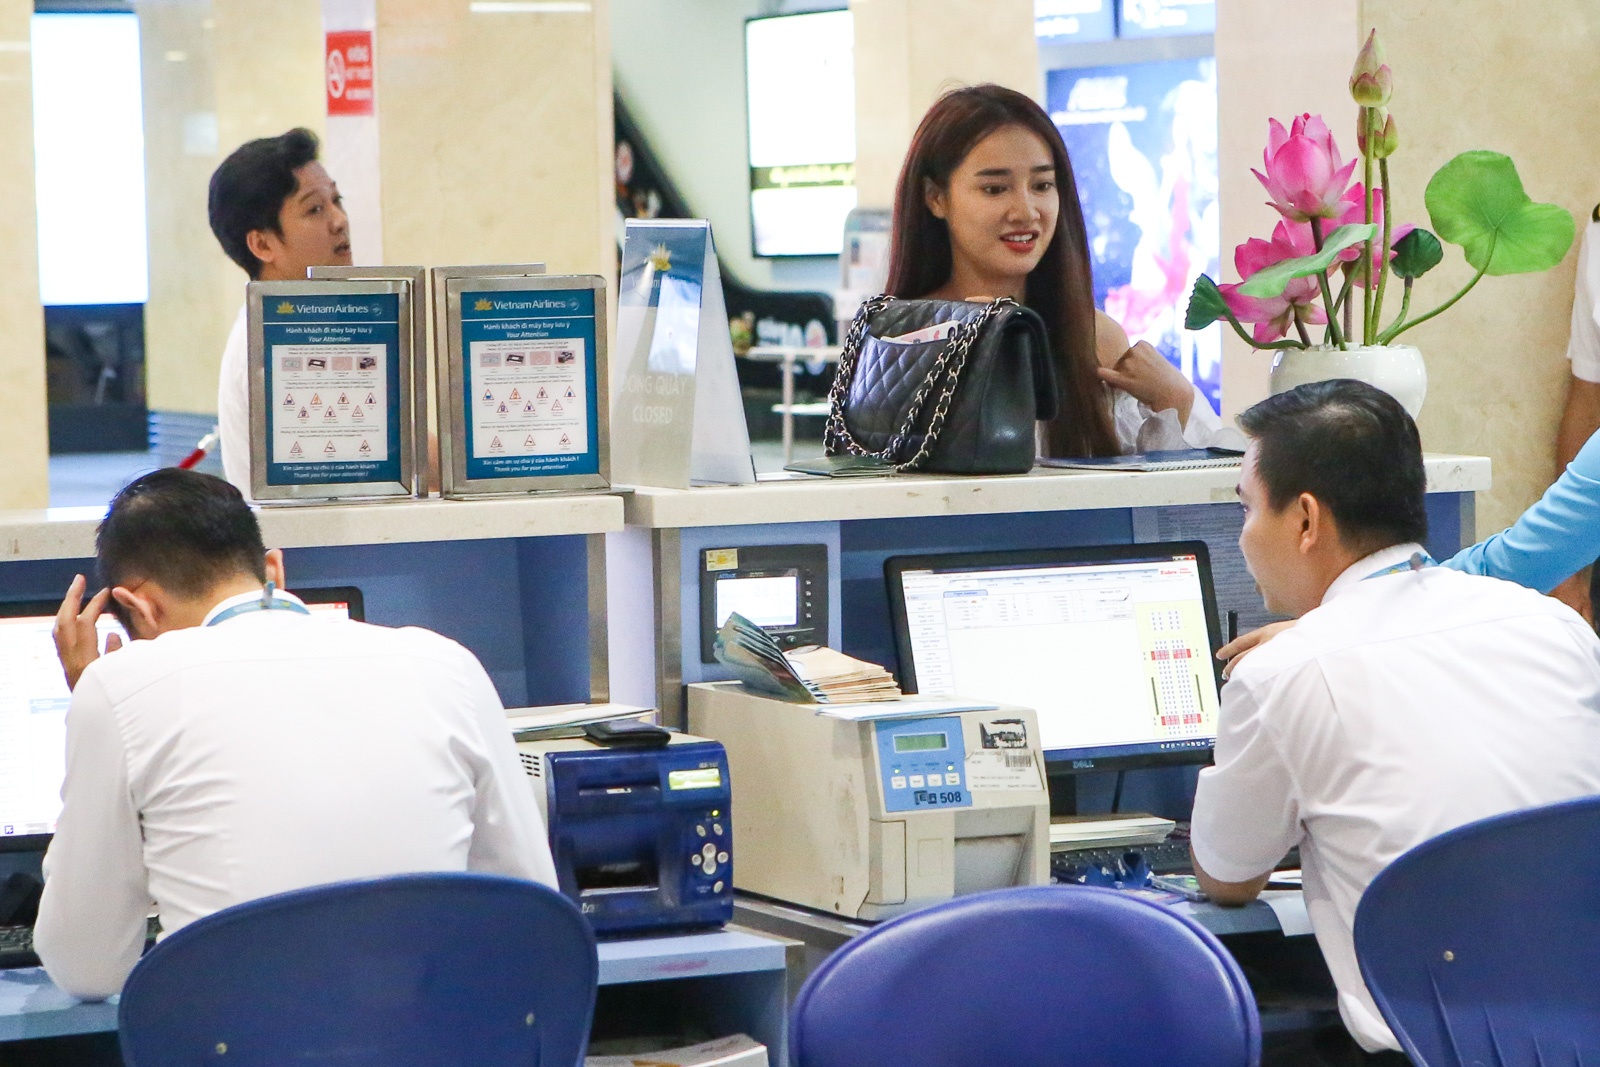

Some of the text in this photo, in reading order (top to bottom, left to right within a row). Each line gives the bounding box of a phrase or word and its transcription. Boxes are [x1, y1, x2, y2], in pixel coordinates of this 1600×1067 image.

[296, 304, 368, 314] Vietnam Airlines
[494, 299, 566, 310] Vietnam Airlines
[633, 405, 672, 424] CLOSED
[940, 791, 962, 804] 508
